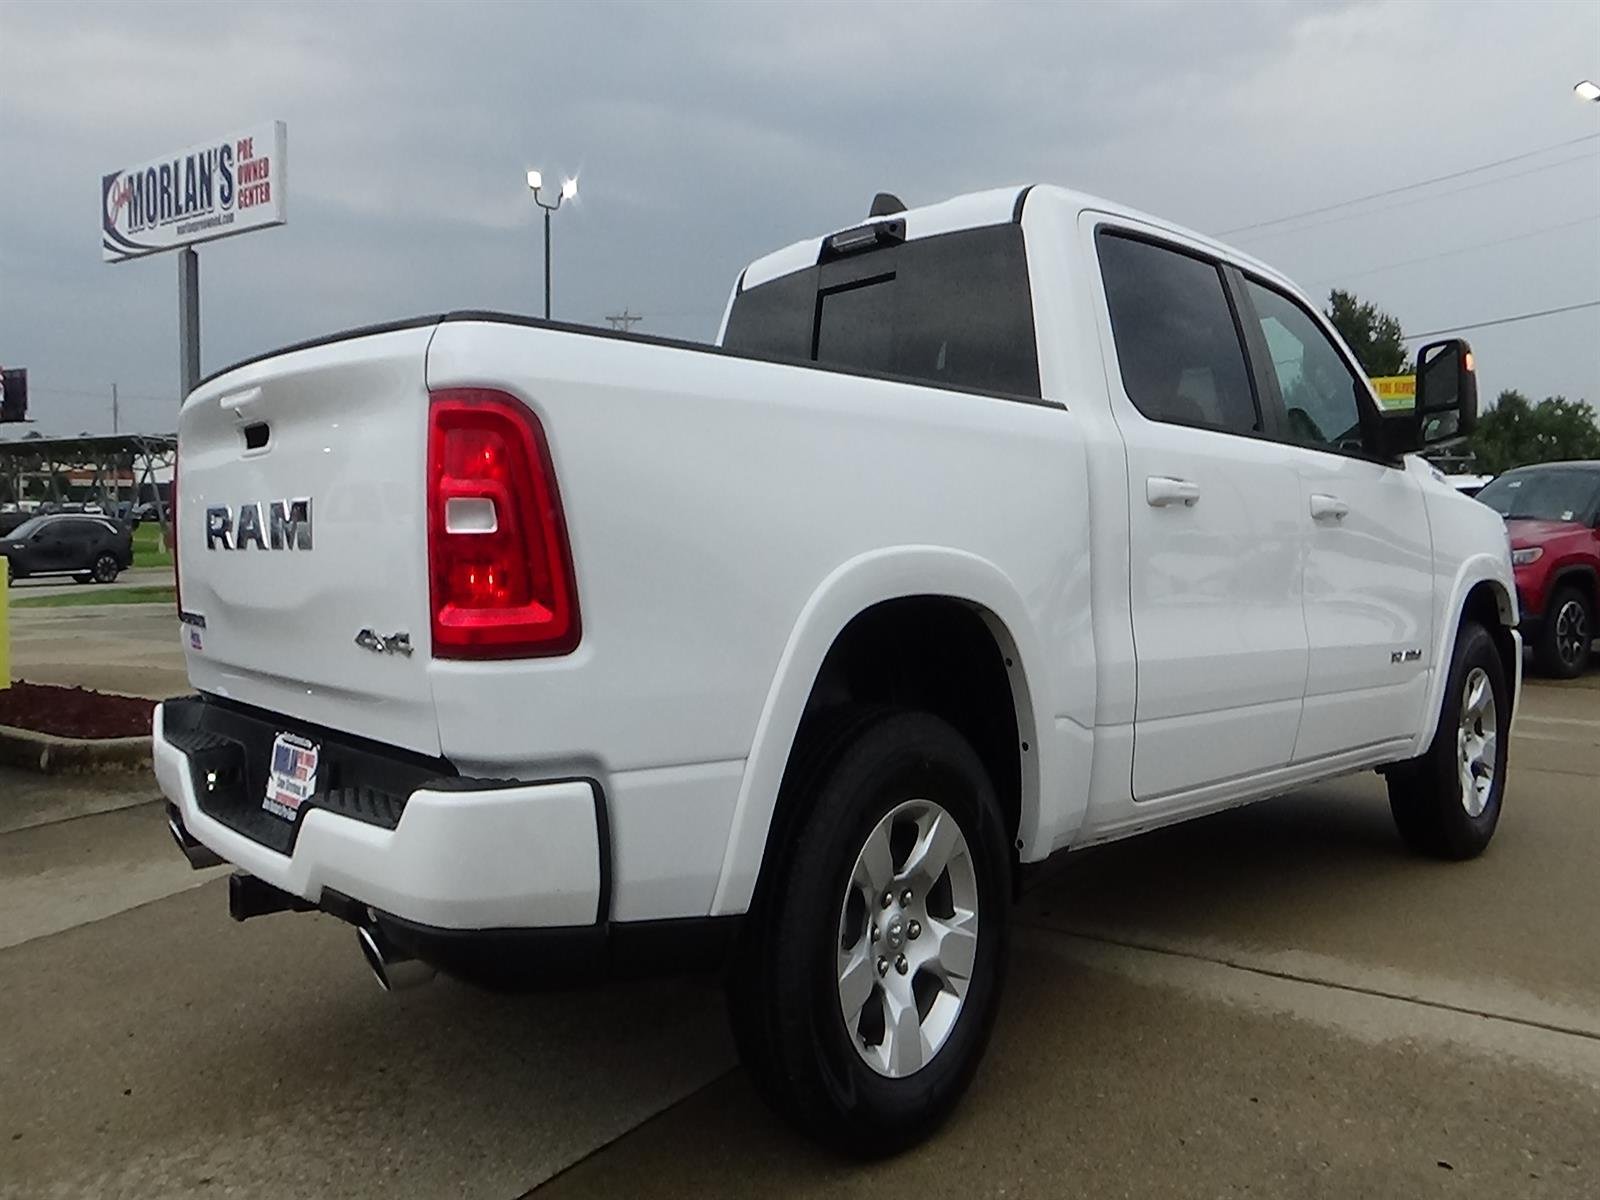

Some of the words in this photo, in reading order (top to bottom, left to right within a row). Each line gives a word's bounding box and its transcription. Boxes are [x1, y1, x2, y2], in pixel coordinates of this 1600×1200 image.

[236, 137, 253, 162] PRE
[237, 157, 269, 186] OWNED
[127, 143, 234, 232] MORLAN'S
[237, 182, 271, 210] CENTER
[206, 497, 313, 551] RAM
